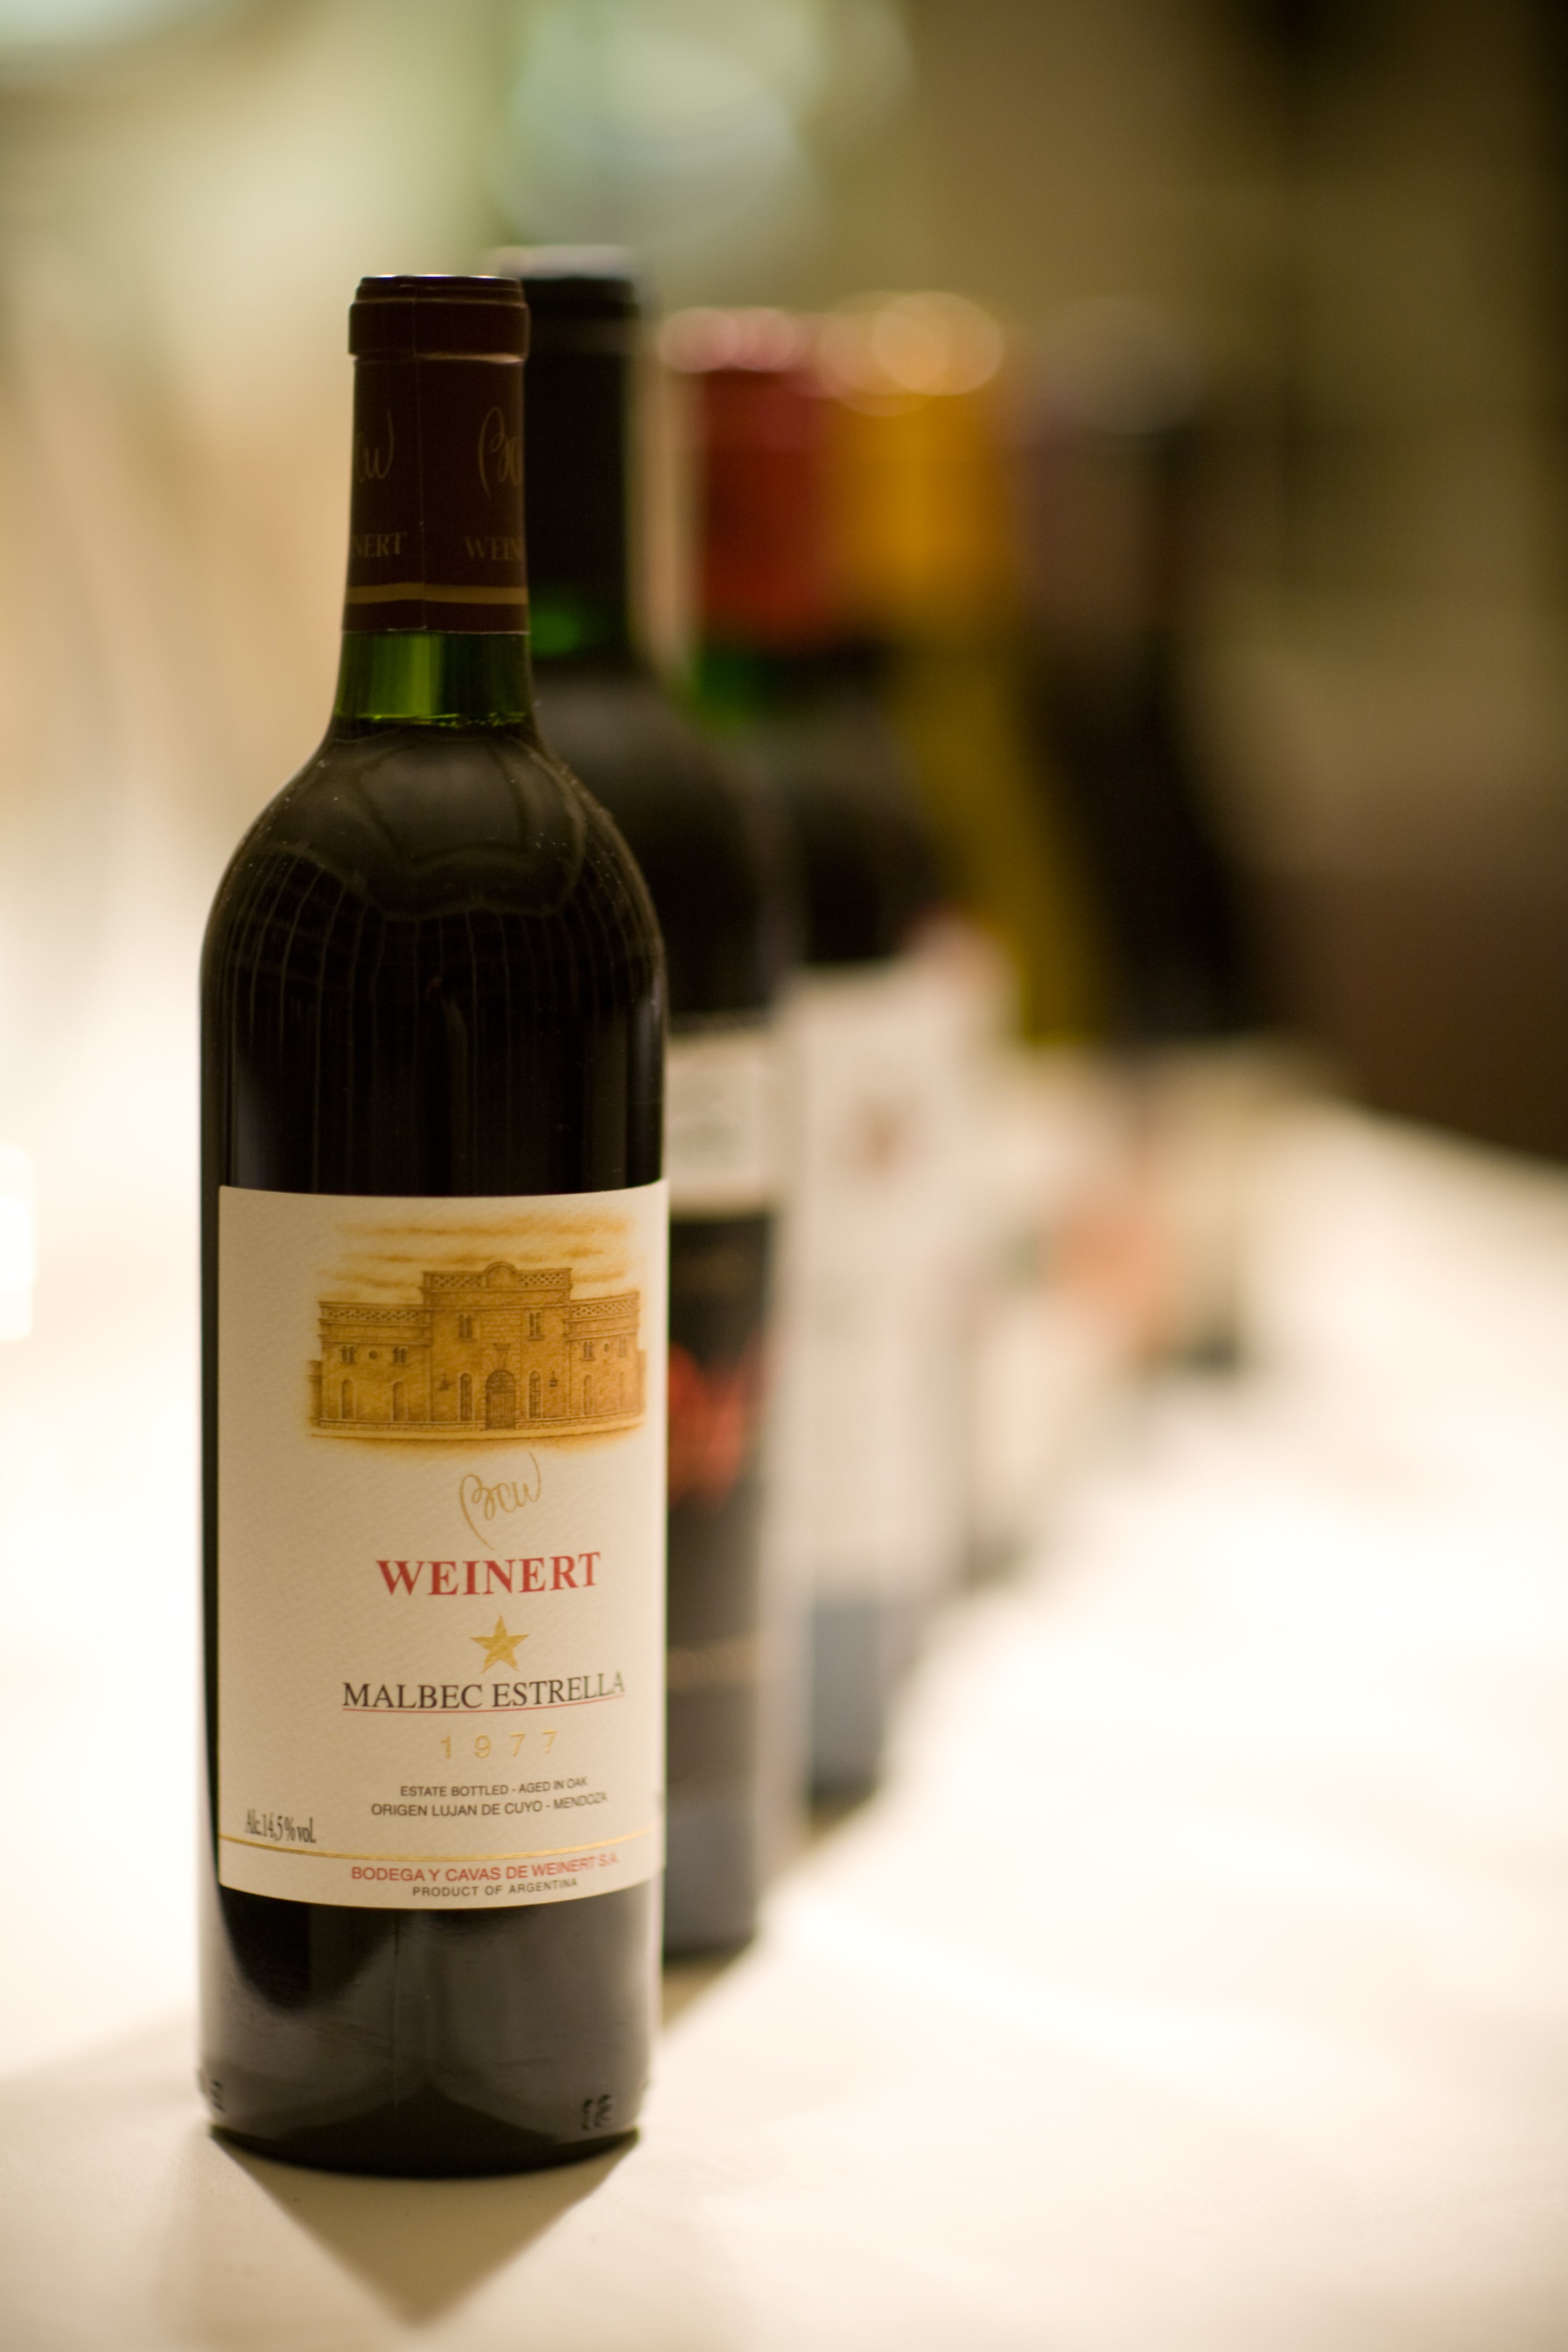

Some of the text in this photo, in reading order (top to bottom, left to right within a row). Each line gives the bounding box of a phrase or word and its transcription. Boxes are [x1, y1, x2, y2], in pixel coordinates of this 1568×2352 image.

[376, 1551, 601, 1595] WEINERT
[342, 1670, 625, 1709] MALBEC ESTRELLA
[400, 1786, 447, 1796] ESTATE
[451, 1784, 509, 1796] BOTTLED
[519, 1781, 550, 1794] AGED
[554, 1780, 564, 1790] IN
[567, 1777, 588, 1789] OAK
[372, 1804, 427, 1816] ORIGEN
[432, 1804, 477, 1816] LUJAN
[482, 1804, 501, 1815] DE
[505, 1801, 542, 1814] CUYO
[554, 1792, 608, 1810] MENDOZA
[352, 1866, 425, 1881] BODEGA
[429, 1868, 440, 1881] Y
[445, 1867, 501, 1881] CAVAS
[506, 1865, 528, 1879] DE
[532, 1856, 596, 1877] WEINERT
[412, 1878, 577, 1897] PRODUCT OF ARGENTINA
